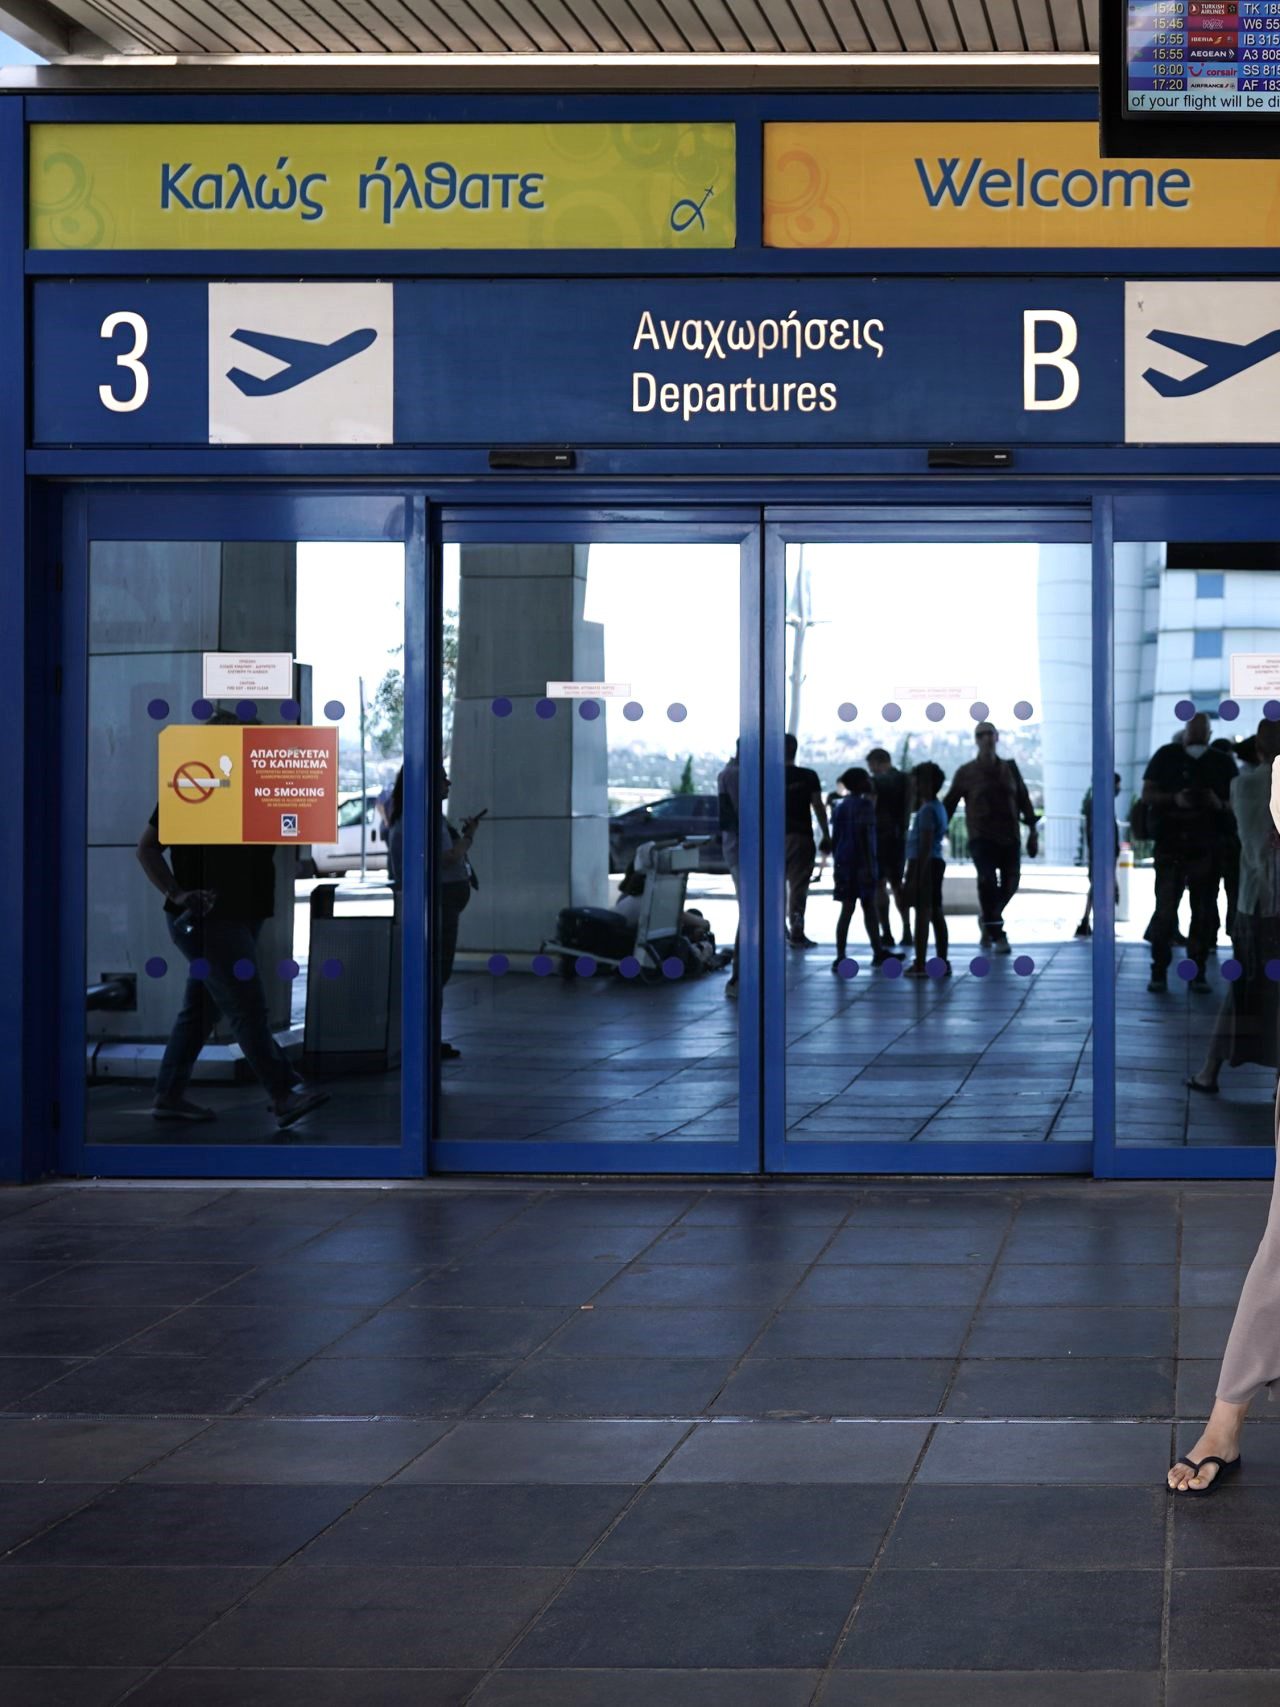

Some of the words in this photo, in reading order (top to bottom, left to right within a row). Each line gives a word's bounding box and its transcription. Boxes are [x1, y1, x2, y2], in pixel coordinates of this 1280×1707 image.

[1153, 2, 1184, 14] 15:40
[1244, 4, 1260, 14] TK
[1152, 19, 1184, 29] 15:45
[1243, 19, 1262, 30] W6
[1152, 34, 1184, 44] 15:55
[1243, 34, 1256, 45] IB
[1152, 49, 1184, 60] 15:55
[1190, 50, 1227, 58] AEGEAN
[1243, 50, 1258, 60] A3
[1152, 65, 1183, 76] 16:00
[1206, 68, 1238, 76] corsair
[1242, 65, 1260, 76] SS
[1152, 80, 1183, 90] 17:20
[1242, 80, 1258, 90] AF
[1132, 95, 1146, 108] of
[1148, 98, 1180, 110] your
[1184, 95, 1217, 110] flight
[1220, 95, 1242, 108] will
[1246, 96, 1264, 108] be
[914, 157, 1191, 208] Welcome
[160, 156, 327, 221] Καλώς
[358, 156, 545, 225] ήλθατε
[632, 310, 884, 359] Αναχωρήσεις
[98, 311, 149, 413] 3
[1023, 309, 1080, 411] B
[632, 372, 837, 422] Departures
[250, 749, 330, 758] ΑΠΑΓΟΡΕΥΕΤΑΙ
[252, 759, 266, 768] ΤΟ
[270, 759, 328, 768] ΚΑΠΝΙΣΜΑ
[254, 788, 270, 797] NO
[274, 788, 325, 797] SMOKING
